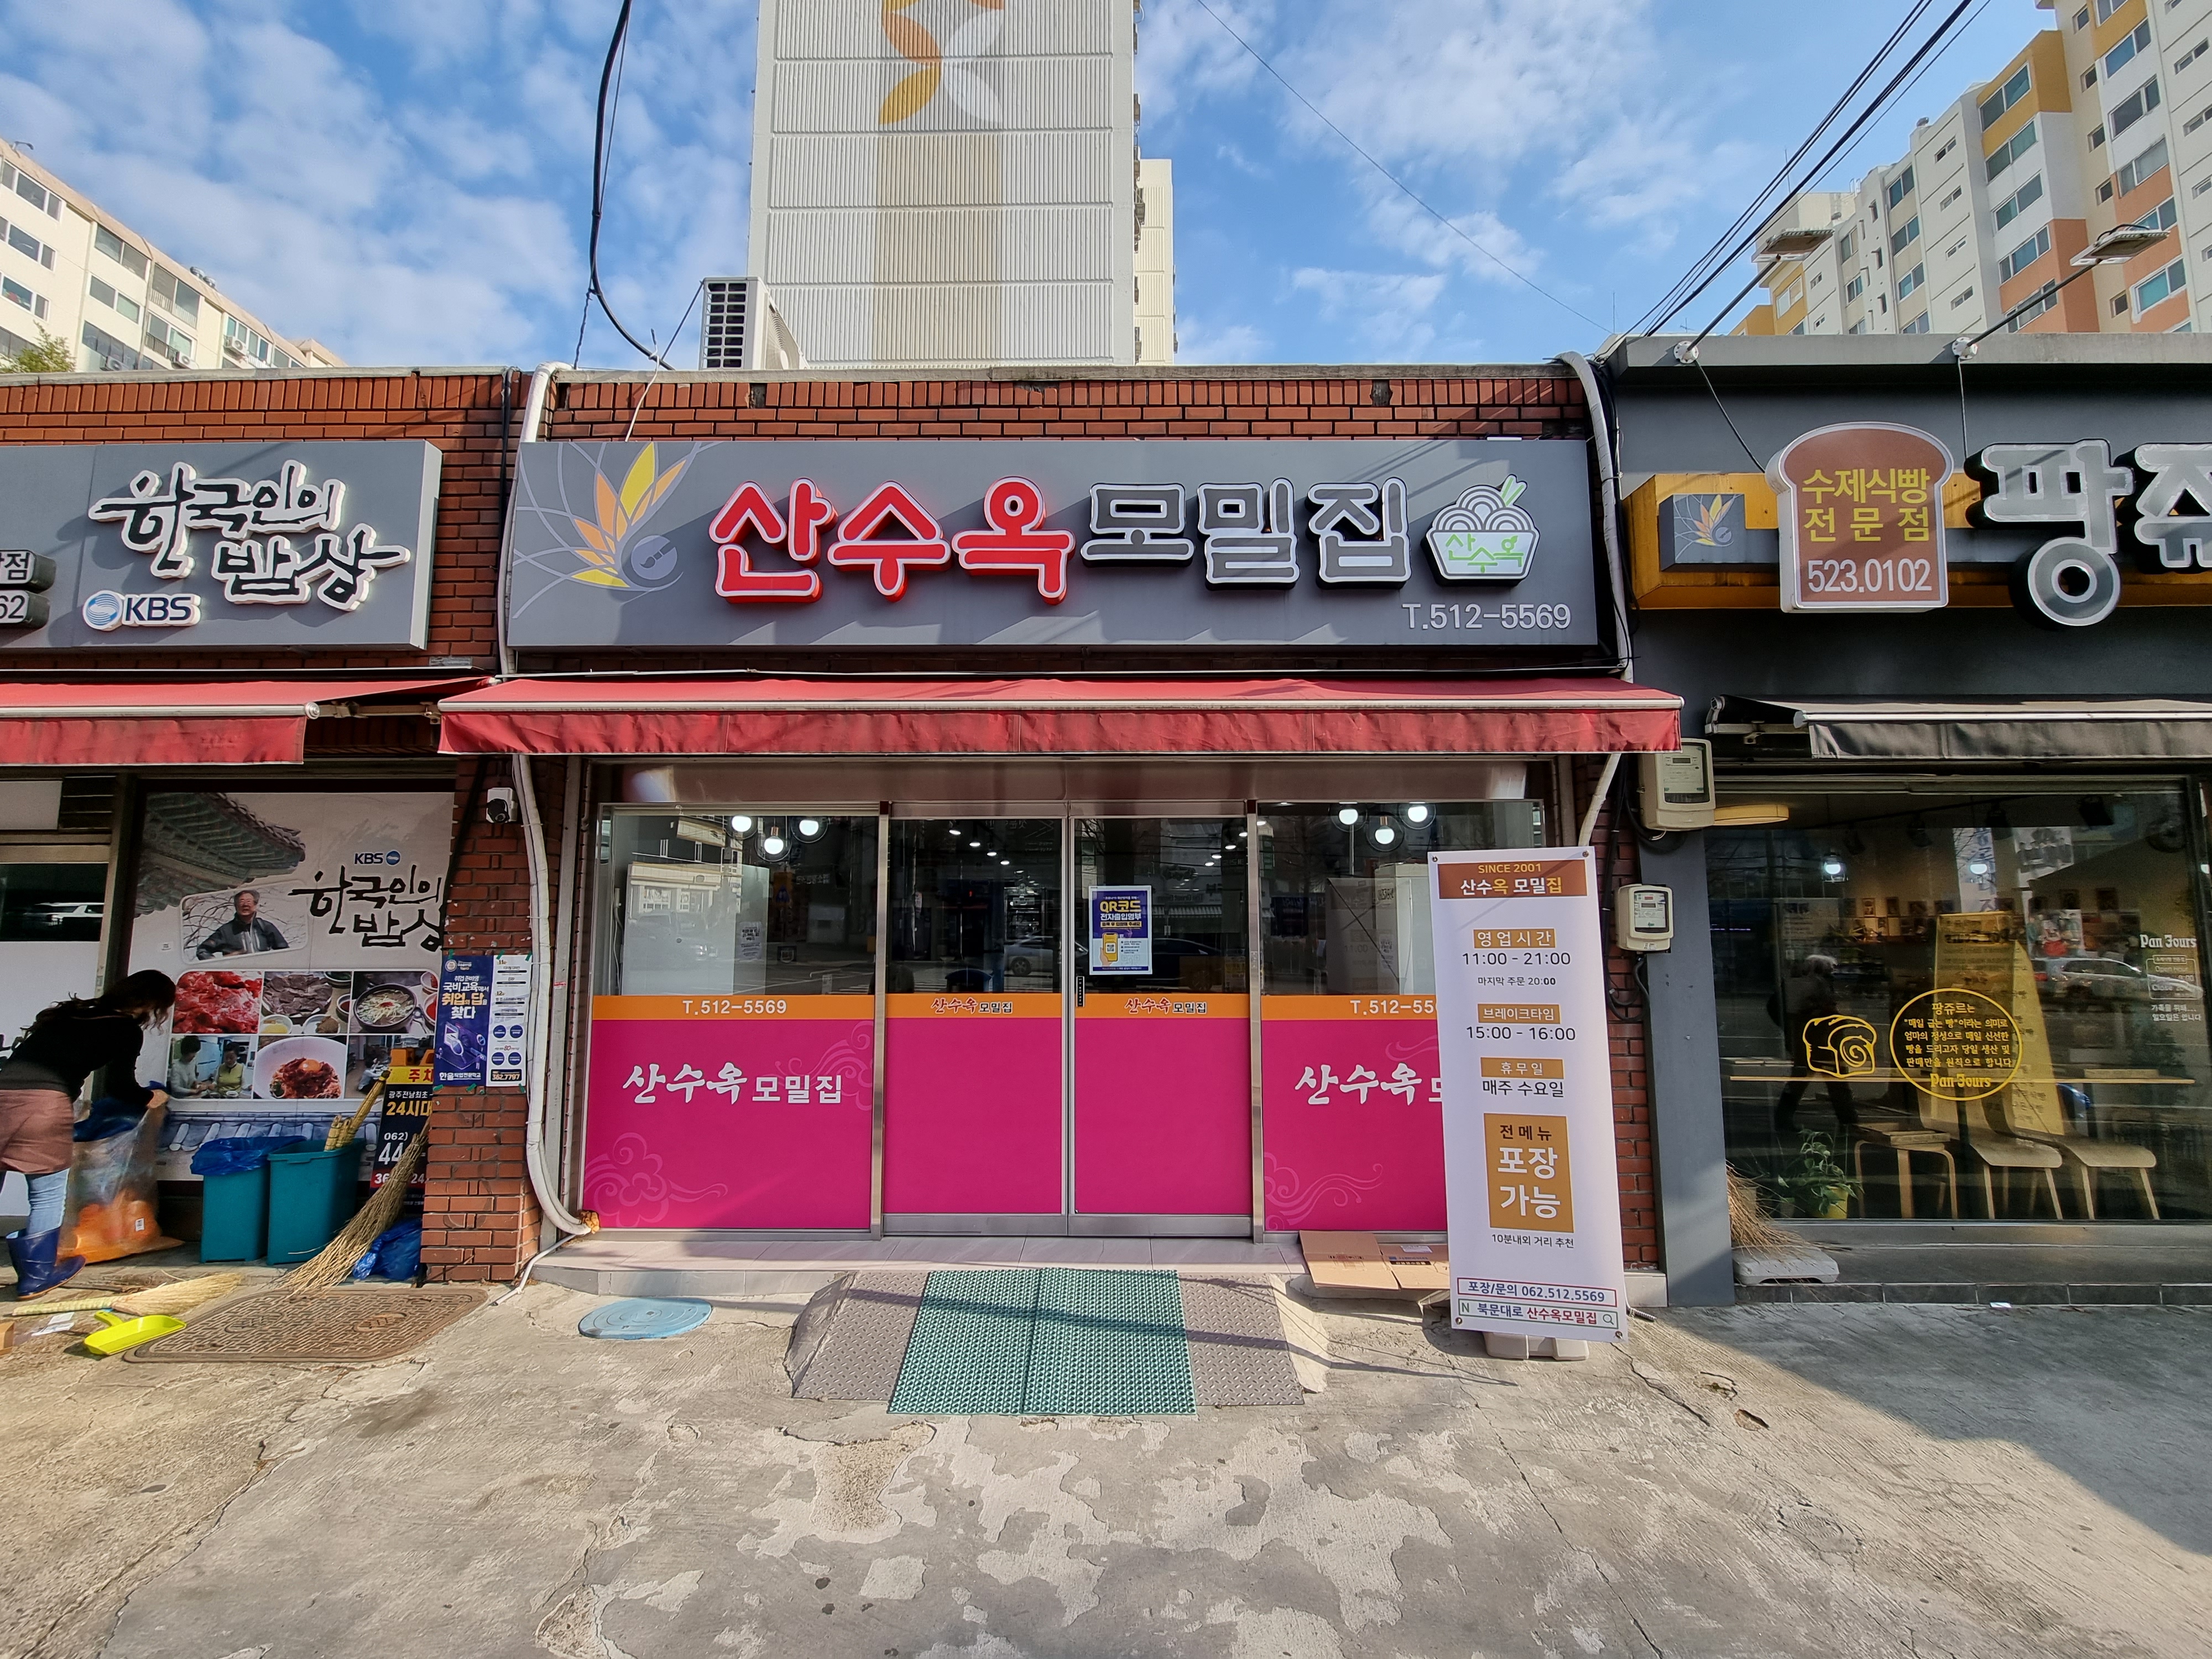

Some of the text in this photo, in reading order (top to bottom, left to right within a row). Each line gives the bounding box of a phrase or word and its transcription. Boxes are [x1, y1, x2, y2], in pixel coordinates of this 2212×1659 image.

[1802, 467, 1930, 504] 수제식빵
[91, 461, 342, 575] 한국인의
[709, 476, 1411, 605] 산수옥 모밀집
[1446, 533, 1524, 573] 산수옥
[0, 552, 30, 580] 점
[213, 524, 409, 609] 밥상
[1807, 558, 1932, 593] 523.0102
[126, 597, 191, 621] KBS
[1401, 603, 1571, 629] T.512-5569
[354, 852, 383, 865] KBS
[1478, 863, 1542, 874] SINCE 2001
[1460, 877, 1563, 896] 산수옥 모밀집
[288, 864, 442, 935] 한국인의
[1100, 900, 1142, 913] QR코드
[2140, 934, 2163, 948] Pan
[1462, 952, 1507, 965] 11:00
[1523, 952, 1571, 965] 21:00
[1478, 977, 1556, 986] 마지막 주문 20:00
[451, 1006, 476, 1019] 찾다
[682, 1000, 787, 1015] T.512-5569
[931, 997, 1014, 1014] 산수옥 모밀집
[1124, 997, 1207, 1014] 산수옥 모밀집
[1350, 1000, 1436, 1015] T.512-55
[1932, 1002, 1975, 1015] 팡쥬르는
[1483, 1008, 1554, 1021] 브레이크타임
[1985, 1019, 2008, 1028] 의미로
[1466, 1026, 1511, 1039] 15:00
[1528, 1027, 1576, 1041] 16:00
[1905, 1031, 2010, 1041] 엄마의 정성으로 매일 신선한
[1906, 1044, 2011, 1055] 빵을 드리고자 당일 생산 및
[1906, 1057, 2013, 1067] 판매만을 원칙으로 합니다
[623, 1062, 842, 1105] 산수옥 모밀집
[1295, 1062, 1422, 1105] 산수옥
[1483, 1080, 1564, 1098] 매주 수요일
[1930, 1073, 1955, 1088] Pan
[1498, 1147, 1558, 1180] 포장
[1500, 1185, 1561, 1219] 가능
[1491, 1234, 1574, 1249] 10분내외 거리 추천
[1468, 1281, 1605, 1302] 포장/문의 062.512.5569
[1462, 1302, 1597, 1325] N 북문대로 산수옥모밀집
